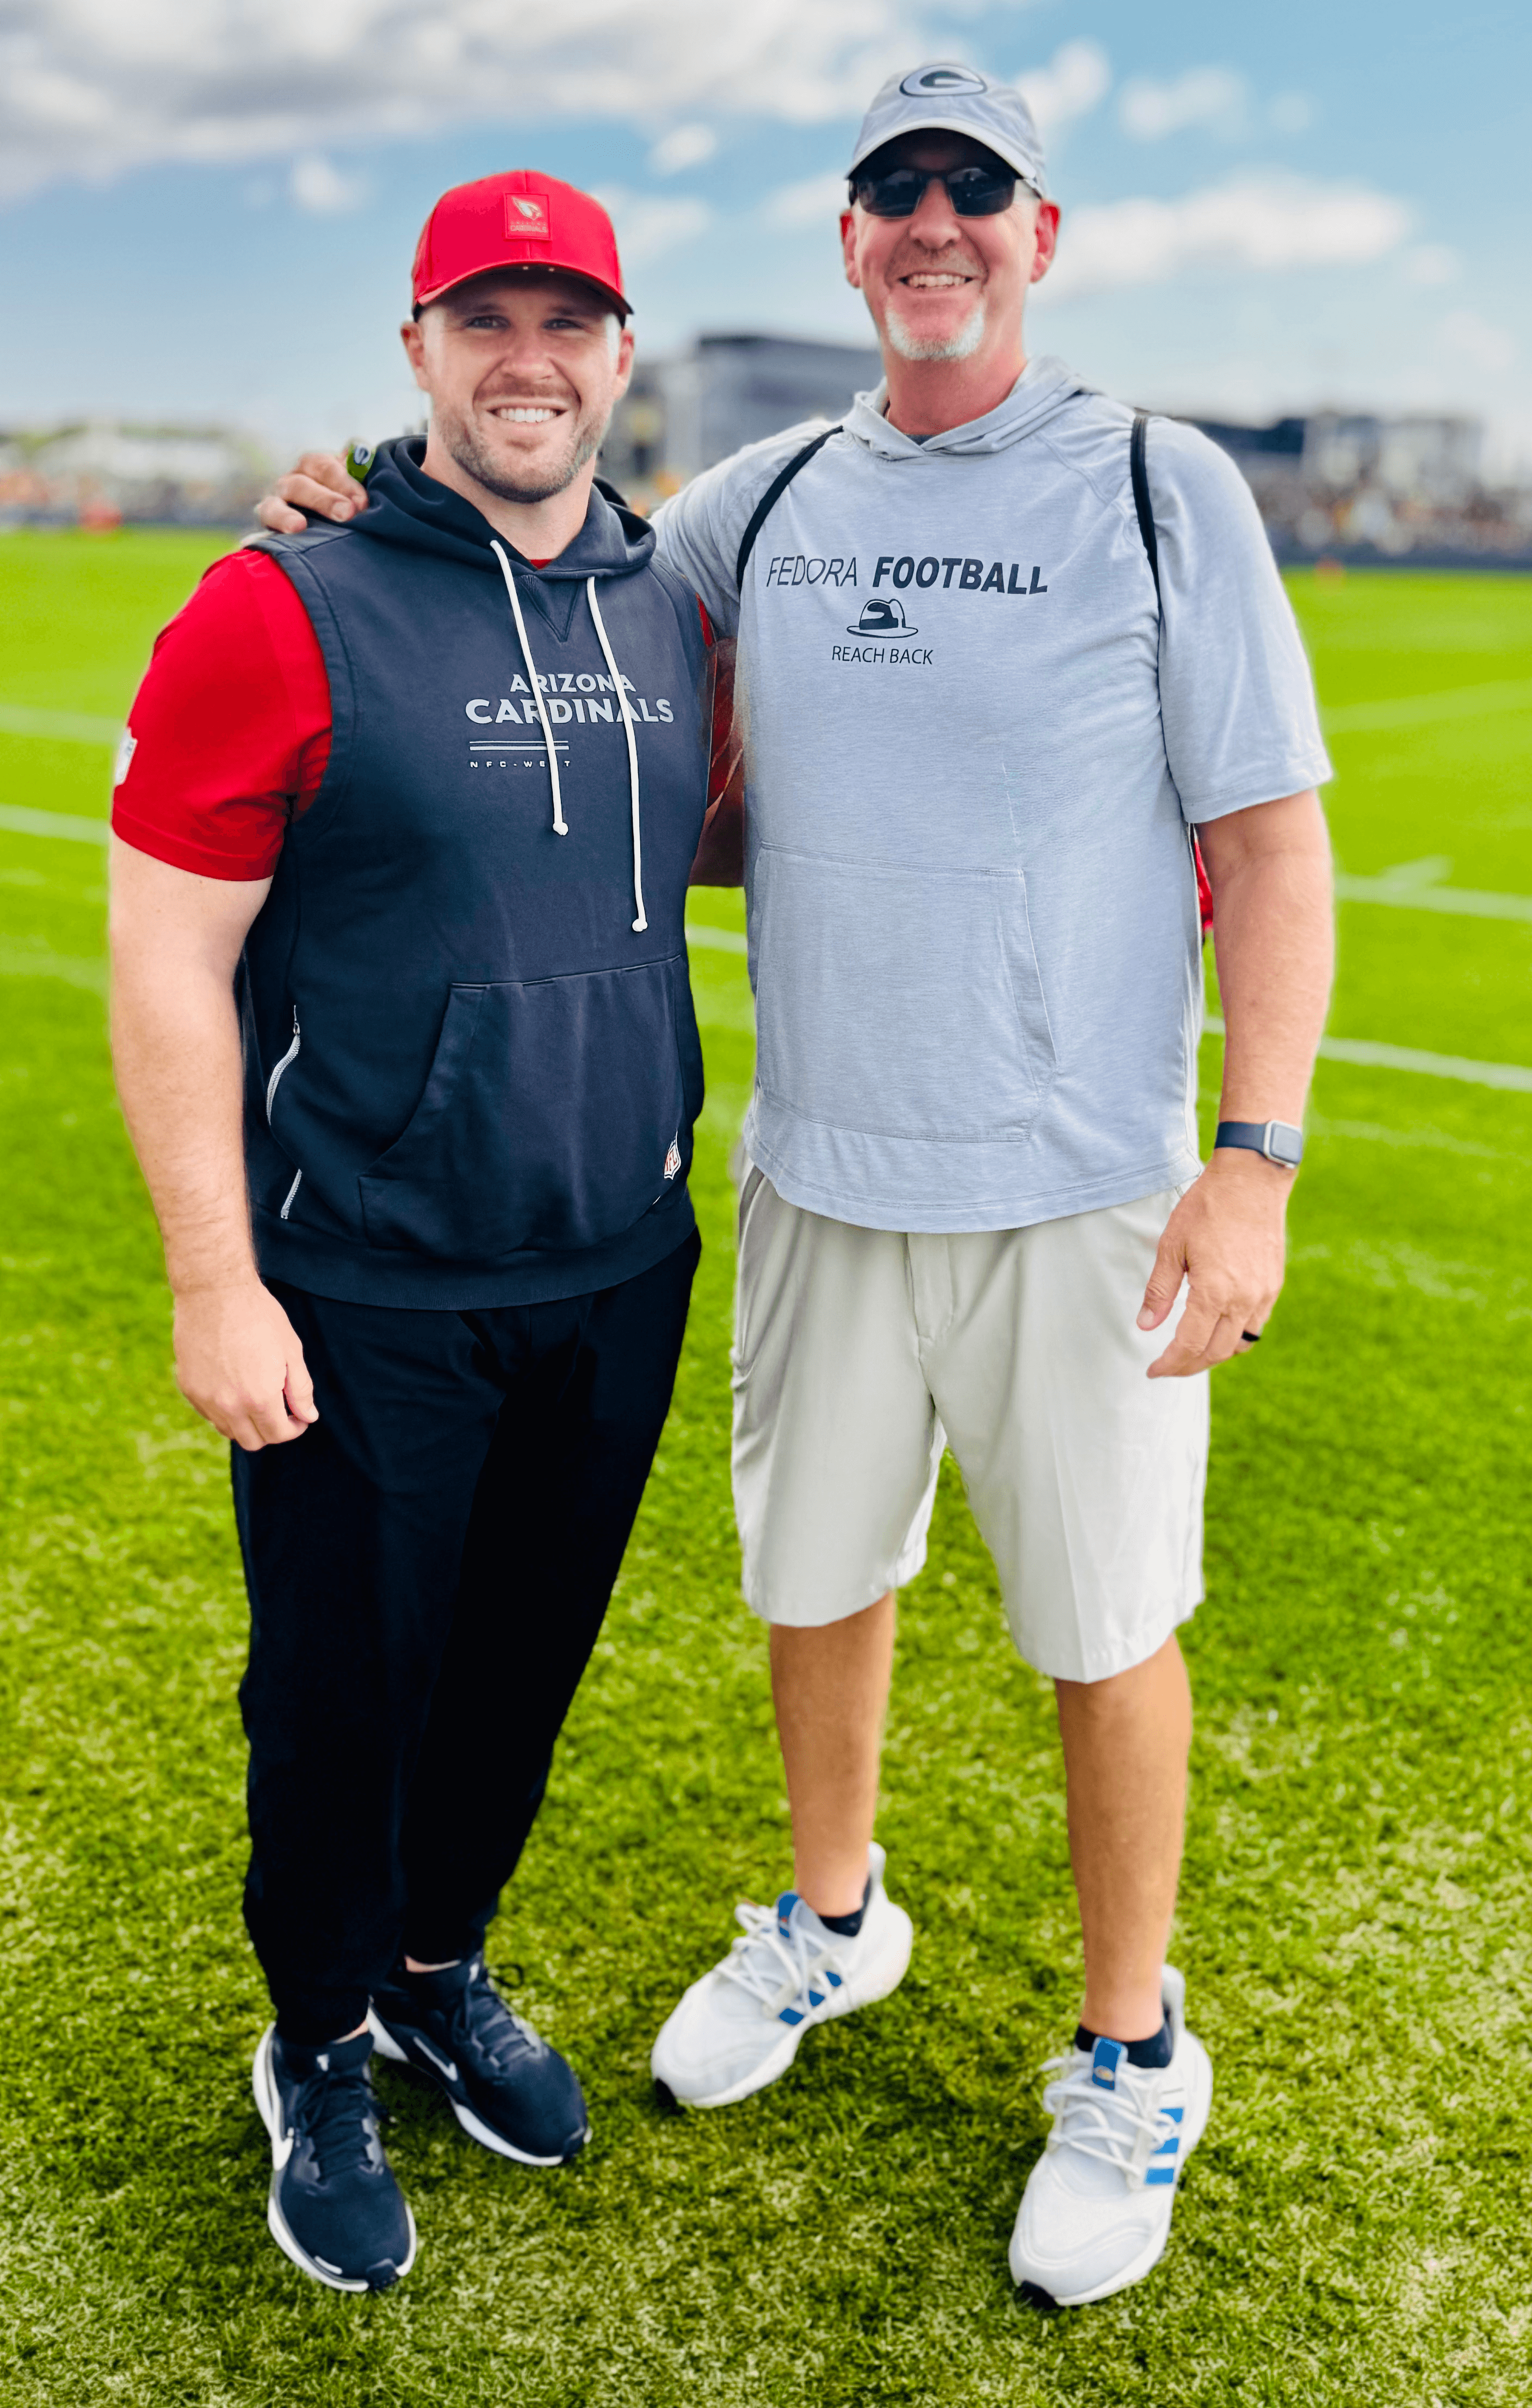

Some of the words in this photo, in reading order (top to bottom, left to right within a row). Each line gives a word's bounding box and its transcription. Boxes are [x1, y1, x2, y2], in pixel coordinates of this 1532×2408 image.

[766, 555, 857, 587] FEDORA
[872, 556, 1048, 595] FOOTBALL
[832, 645, 885, 663] REACH
[889, 648, 934, 665] BACK
[510, 673, 637, 693] ARIZONA
[465, 698, 674, 724] CARDINALS
